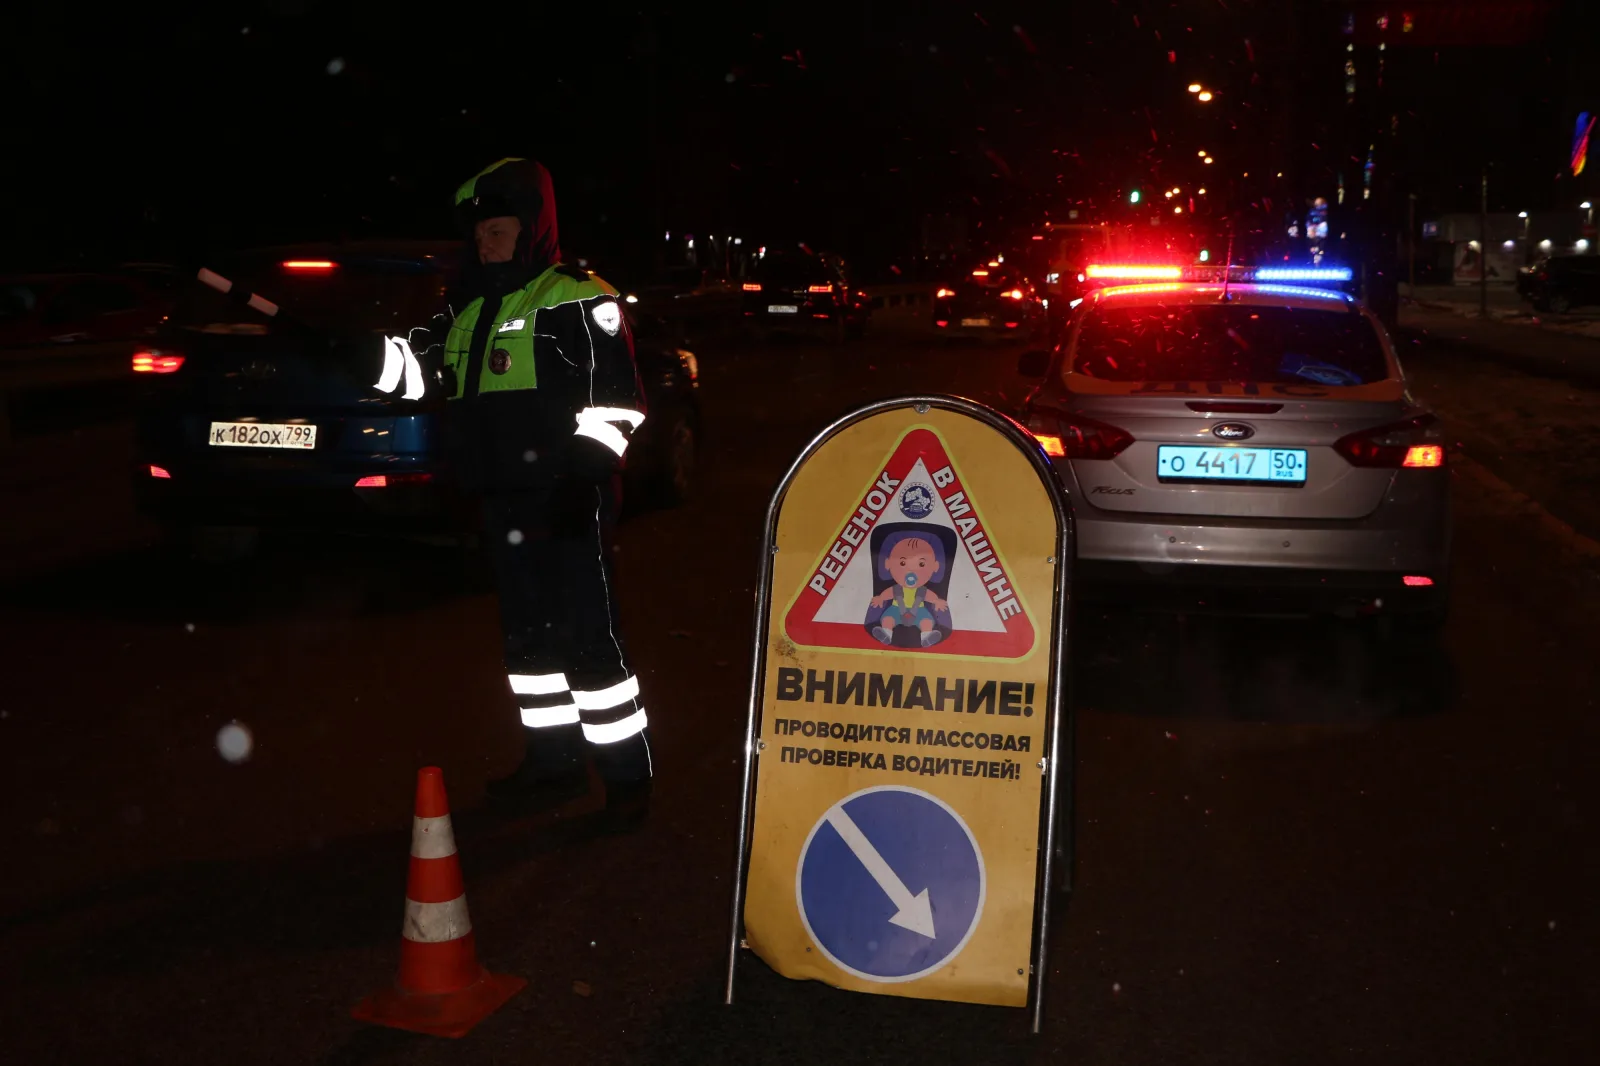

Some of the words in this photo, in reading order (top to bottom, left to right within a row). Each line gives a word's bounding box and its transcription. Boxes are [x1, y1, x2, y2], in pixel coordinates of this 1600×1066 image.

[285, 426, 312, 441] 799
[1219, 427, 1245, 438] Ford
[1195, 451, 1257, 475] 4417
[1273, 452, 1298, 470] 50
[1275, 470, 1294, 478] RUS
[808, 470, 902, 597] РЕБЕНОК
[931, 466, 955, 490] В
[943, 491, 1022, 622] МАШИНЕ
[776, 666, 1036, 718] ВНИМАНИЕ!
[774, 718, 911, 744] ПРОВОДИТСЯ
[916, 728, 1031, 752] МАССОВАЯ
[780, 746, 887, 771] ПРОВЕРКА
[892, 755, 1021, 780] ВОДИТЕЛЕЙ!
